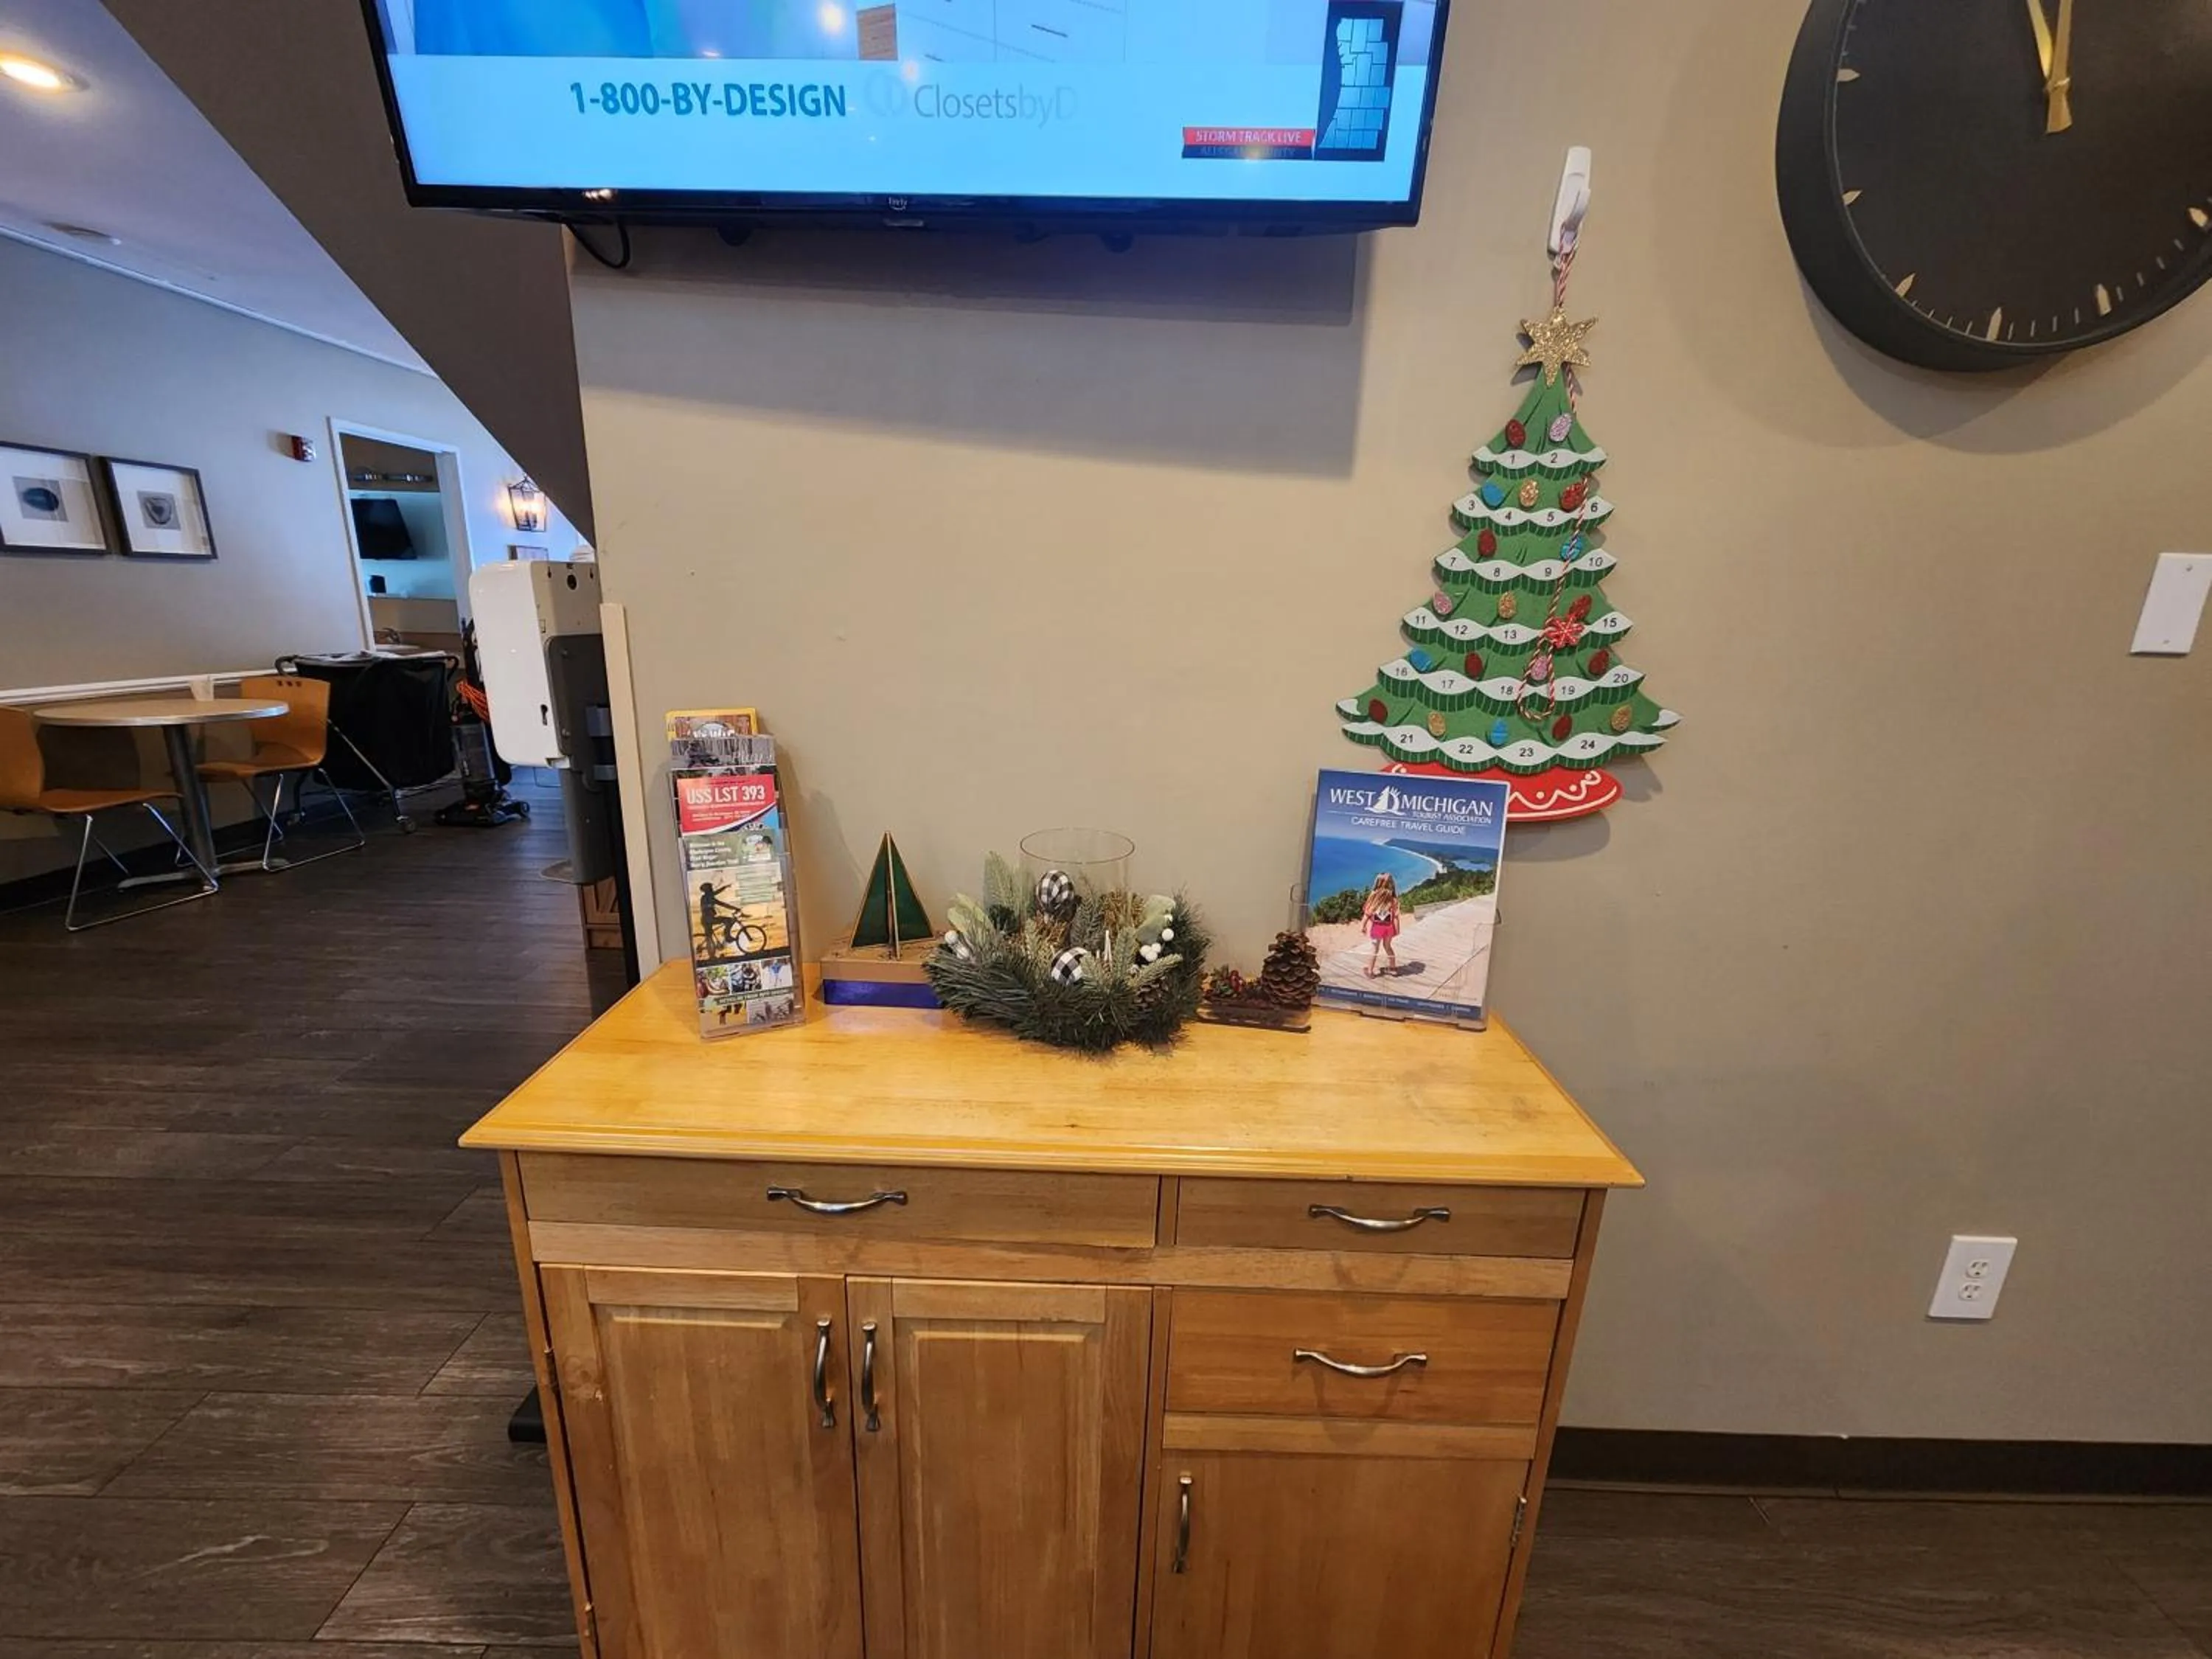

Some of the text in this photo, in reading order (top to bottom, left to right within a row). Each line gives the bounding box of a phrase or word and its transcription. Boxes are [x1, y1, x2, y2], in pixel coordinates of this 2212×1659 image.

[570, 82, 846, 117] 1-800-BY-DESIGN
[1196, 130, 1302, 143] STORM TRACK LIVE
[1510, 455, 1516, 464] 1
[1551, 453, 1558, 463] 2
[1468, 500, 1475, 510] 3
[1590, 501, 1598, 512] 6
[1505, 511, 1512, 521] 4
[1546, 512, 1554, 522] 5
[1450, 557, 1456, 566] 7
[1589, 557, 1604, 567] 10
[1493, 567, 1500, 577] 8
[1545, 567, 1552, 577] 9
[1416, 615, 1426, 625] 11
[1603, 618, 1617, 627] 15
[1454, 625, 1468, 635] 12
[1503, 630, 1517, 639] 13
[1395, 667, 1408, 676] 16
[1613, 673, 1629, 684] 20
[1441, 680, 1455, 689] 17
[1500, 686, 1513, 695] 18
[1562, 686, 1576, 695] 19
[1400, 734, 1413, 743] 21
[1459, 745, 1474, 754] 22
[1580, 740, 1595, 750] 24
[1520, 748, 1534, 757] 23
[686, 785, 765, 804] USS LST 393
[1330, 787, 1493, 817] WEST MICHIGAN
[1412, 812, 1492, 824] TOURIST ASSOCIATION
[1351, 816, 1466, 835] CAREFREE TRAVEL GUIDE
